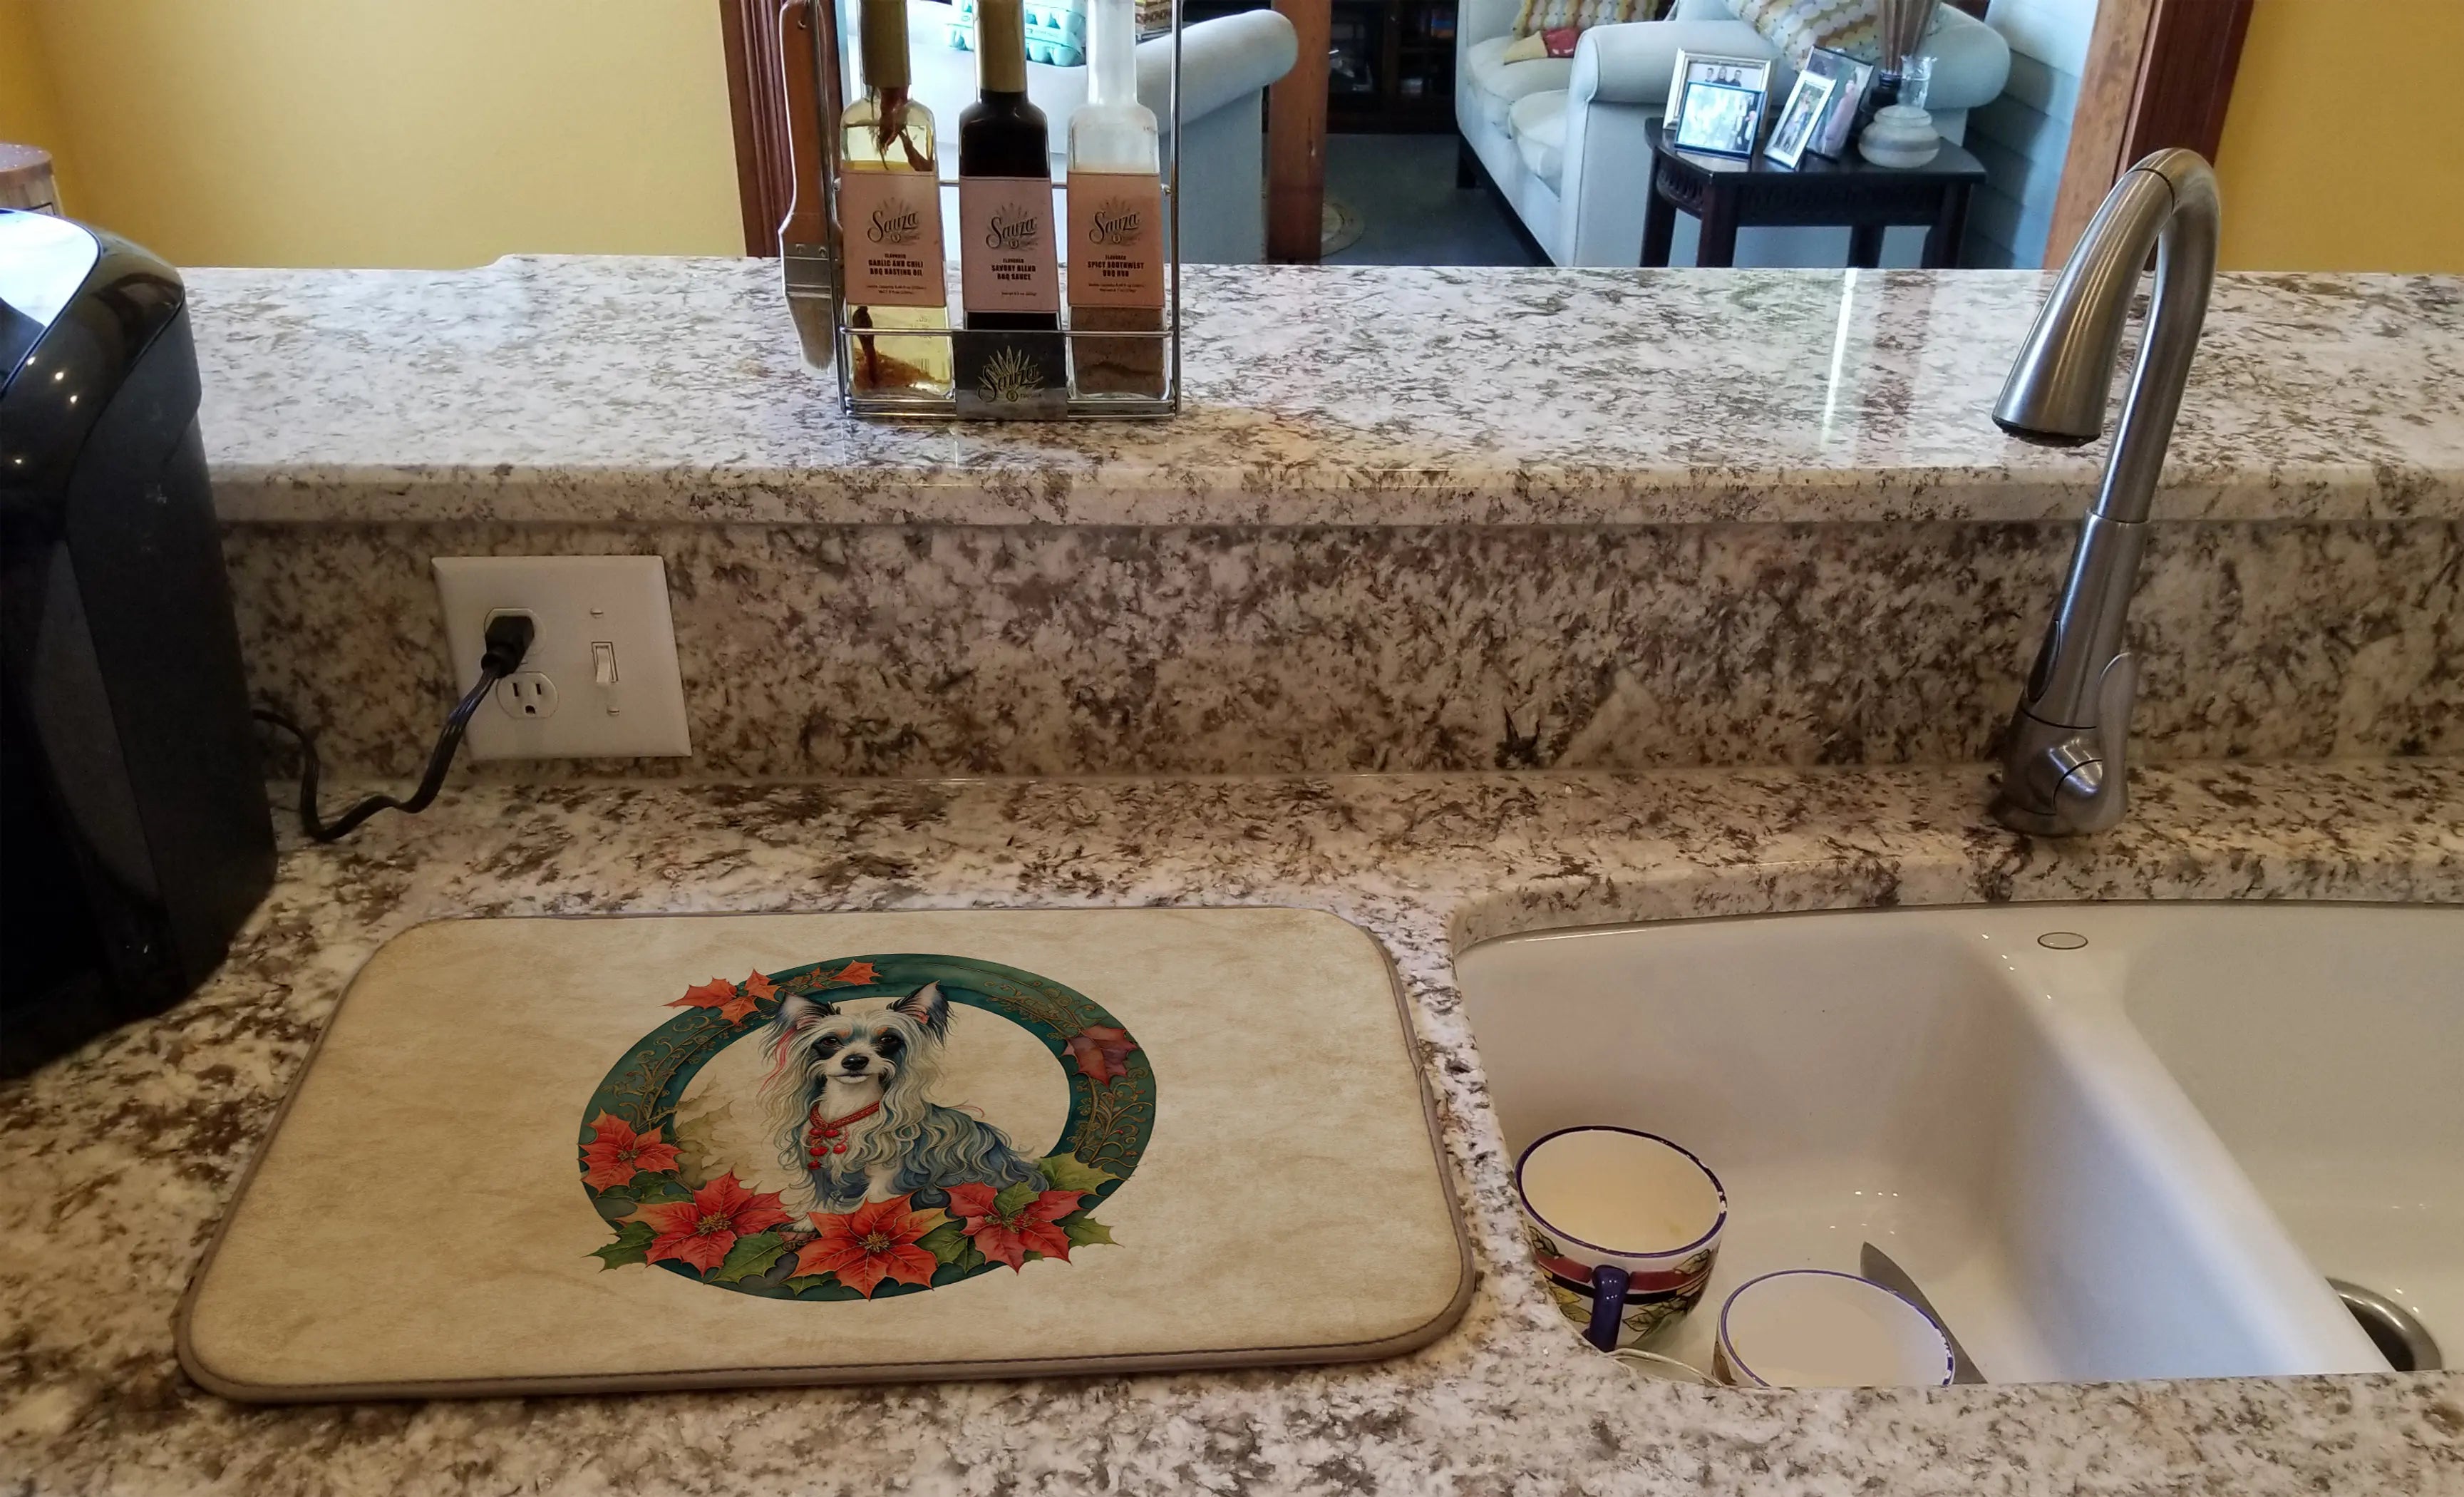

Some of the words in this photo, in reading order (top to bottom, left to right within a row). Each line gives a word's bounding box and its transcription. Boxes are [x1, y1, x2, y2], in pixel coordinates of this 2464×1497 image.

[867, 210, 919, 242] Sauza
[986, 217, 1036, 249] Sauza
[1089, 211, 1140, 245] Sauza
[976, 364, 1043, 403] Sauza
